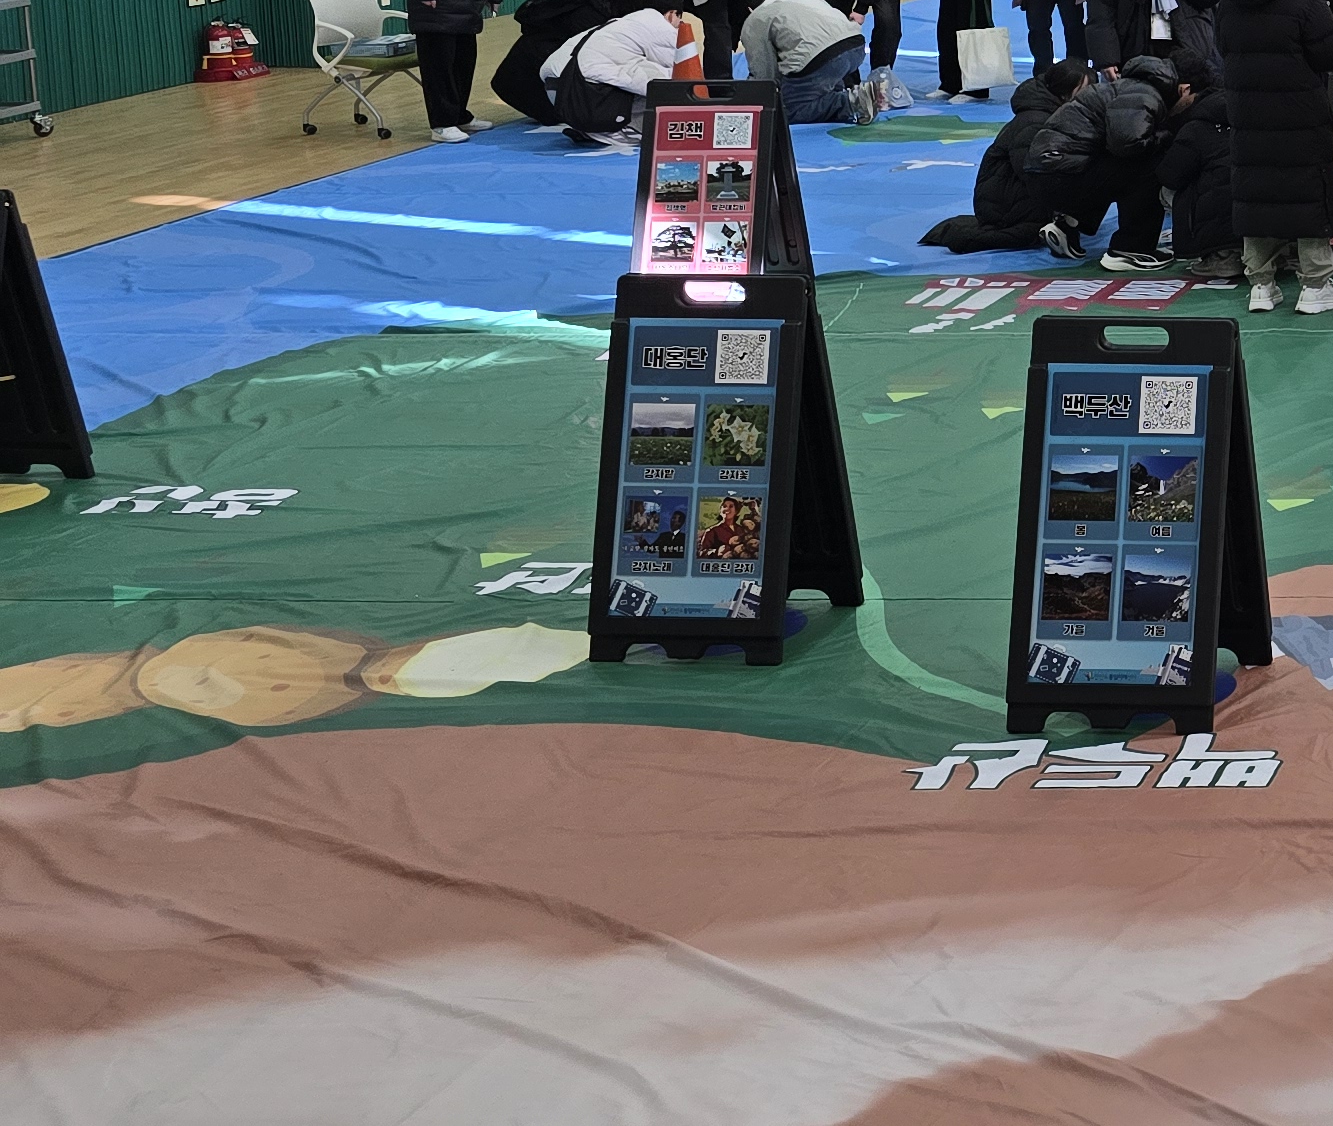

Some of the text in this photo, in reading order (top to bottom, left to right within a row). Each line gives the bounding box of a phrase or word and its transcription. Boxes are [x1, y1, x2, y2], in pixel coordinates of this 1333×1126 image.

[668, 121, 704, 140] 김책
[642, 346, 708, 369] 대홍단
[1062, 394, 1132, 419] 백두산
[644, 468, 674, 479] 감자밭
[719, 469, 749, 480] 감자꽃
[1075, 524, 1086, 536] 봄
[1150, 525, 1171, 537] 여름
[632, 561, 672, 572] 감자노래
[701, 562, 755, 573] 대홍단 감자
[1063, 624, 1085, 636] 가을
[1144, 625, 1166, 637] 겨울
[901, 732, 1284, 790] 백두산
